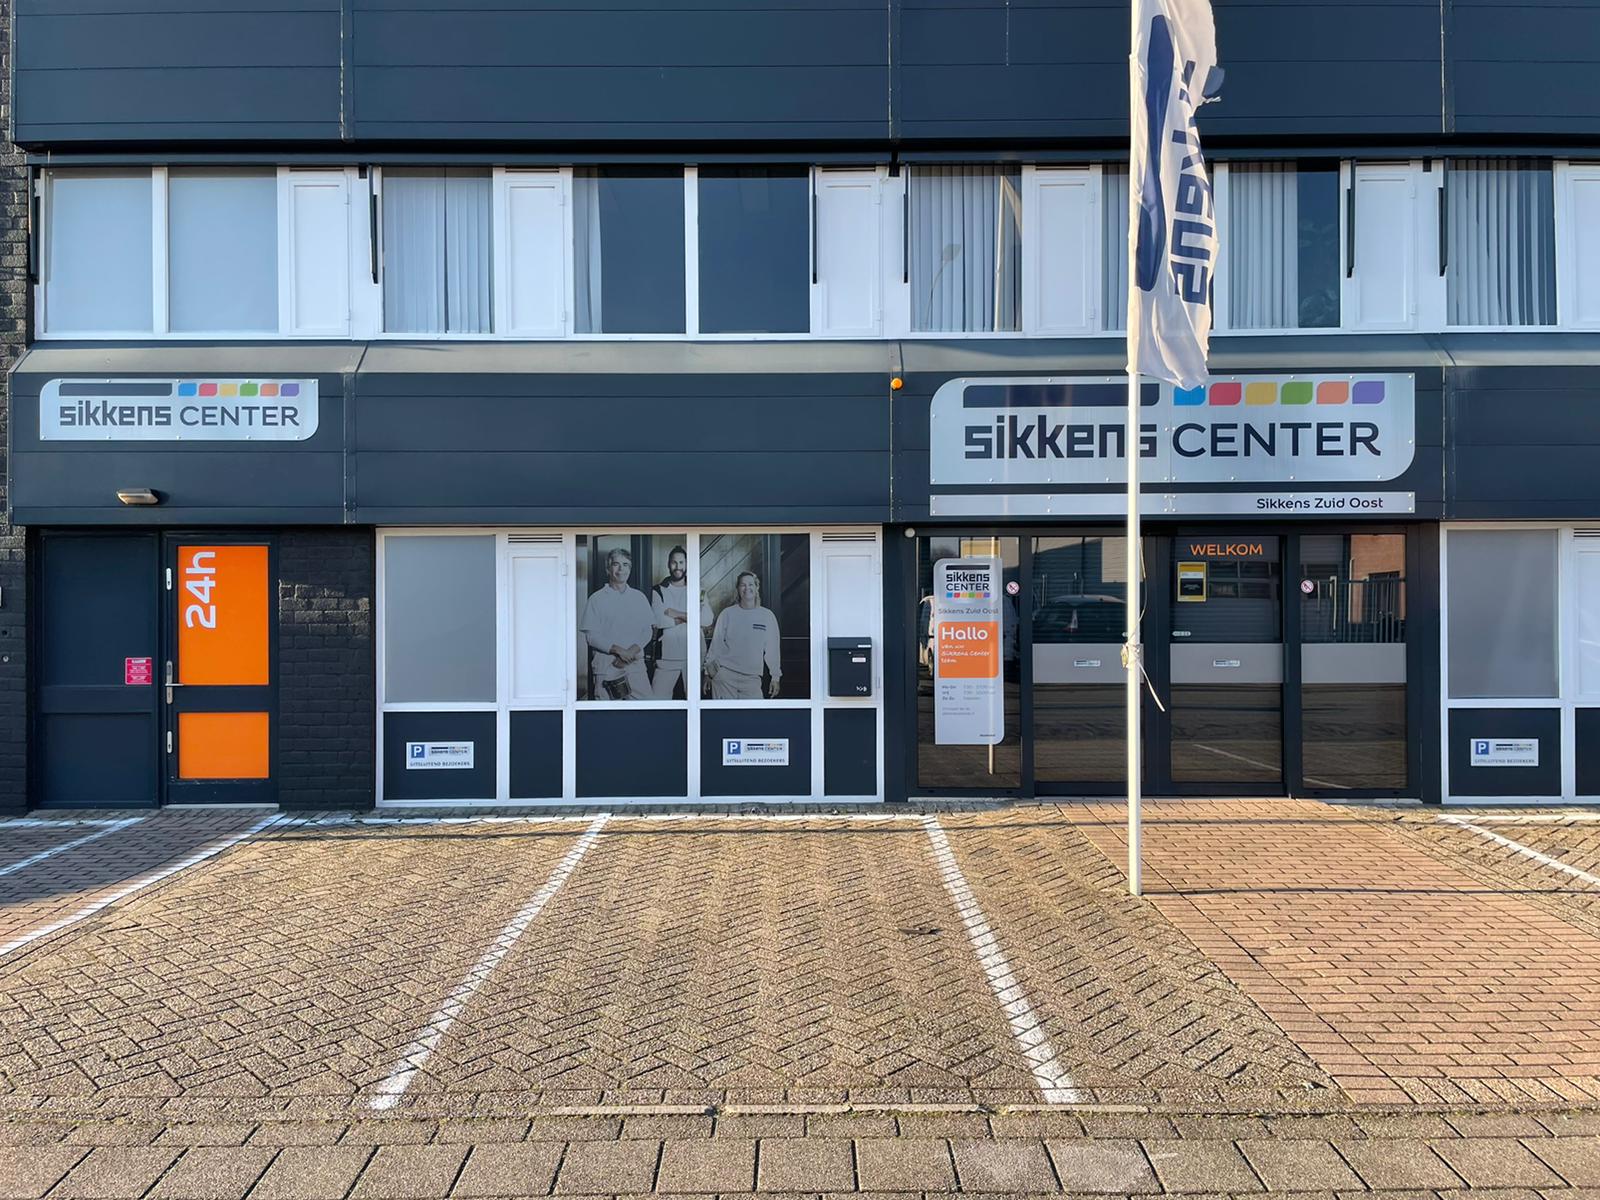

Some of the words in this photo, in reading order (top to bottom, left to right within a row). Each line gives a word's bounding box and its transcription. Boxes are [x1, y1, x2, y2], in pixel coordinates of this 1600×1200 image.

[60, 400, 171, 426] sikkens
[179, 406, 299, 426] CENTER
[965, 415, 1157, 459] sikkens
[1172, 421, 1382, 457] CENTER
[1256, 498, 1311, 509] Sikkens
[1314, 497, 1345, 508] Zuid
[1349, 497, 1383, 508] Oost
[1190, 543, 1263, 556] WELKOM
[946, 572, 990, 582] sikkens
[185, 551, 216, 628] 24h
[946, 583, 990, 591] CENTER
[941, 627, 988, 640] Hallo
[413, 746, 422, 757] P
[730, 743, 739, 754] P
[1478, 743, 1487, 754] P
